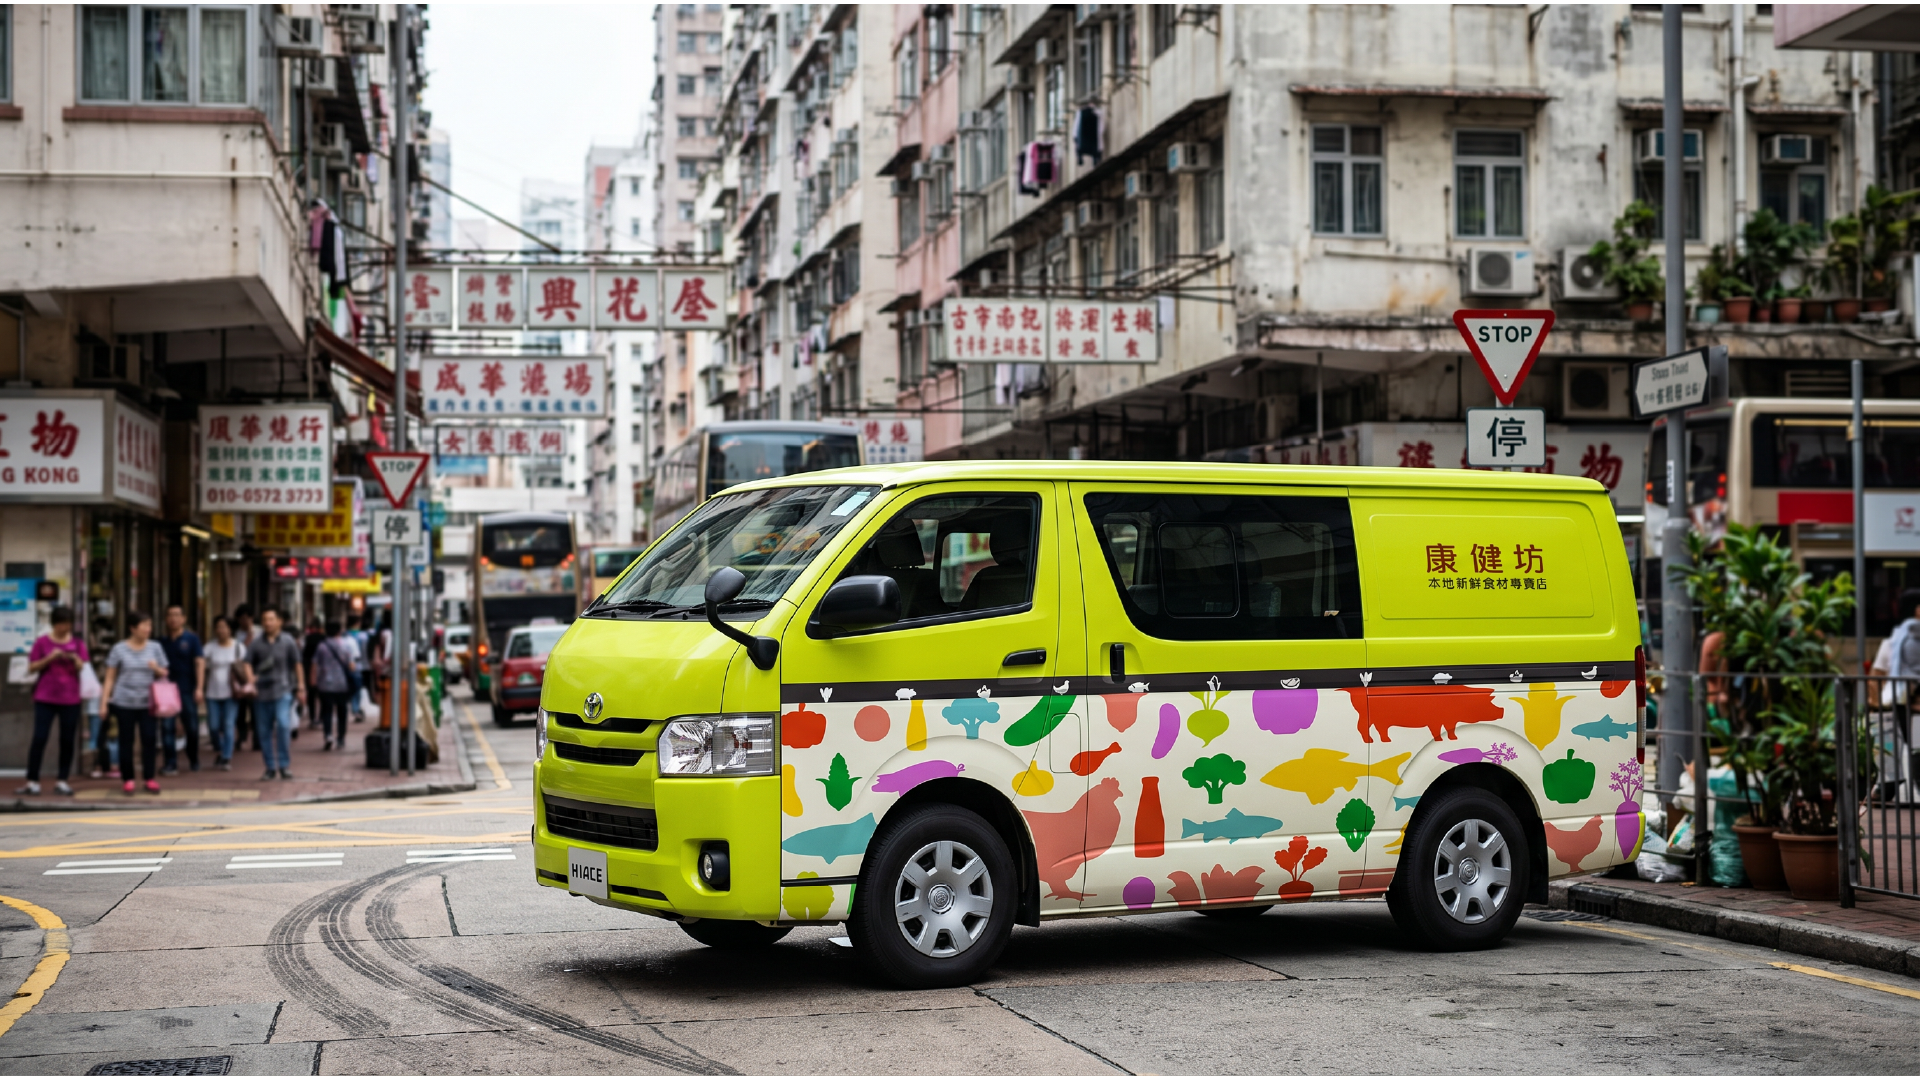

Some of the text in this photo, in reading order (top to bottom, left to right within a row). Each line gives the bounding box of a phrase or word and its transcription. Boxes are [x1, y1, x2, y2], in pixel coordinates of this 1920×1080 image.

[1478, 325, 1533, 343] STOP
[1486, 416, 1527, 457] 停
[24, 467, 80, 484] KONG
[381, 461, 415, 472] STOP
[384, 514, 410, 541] 停
[1425, 543, 1544, 574] 康健坊
[1428, 577, 1547, 590] 本地新鮮食材專賣店
[571, 862, 603, 883] HIACE
